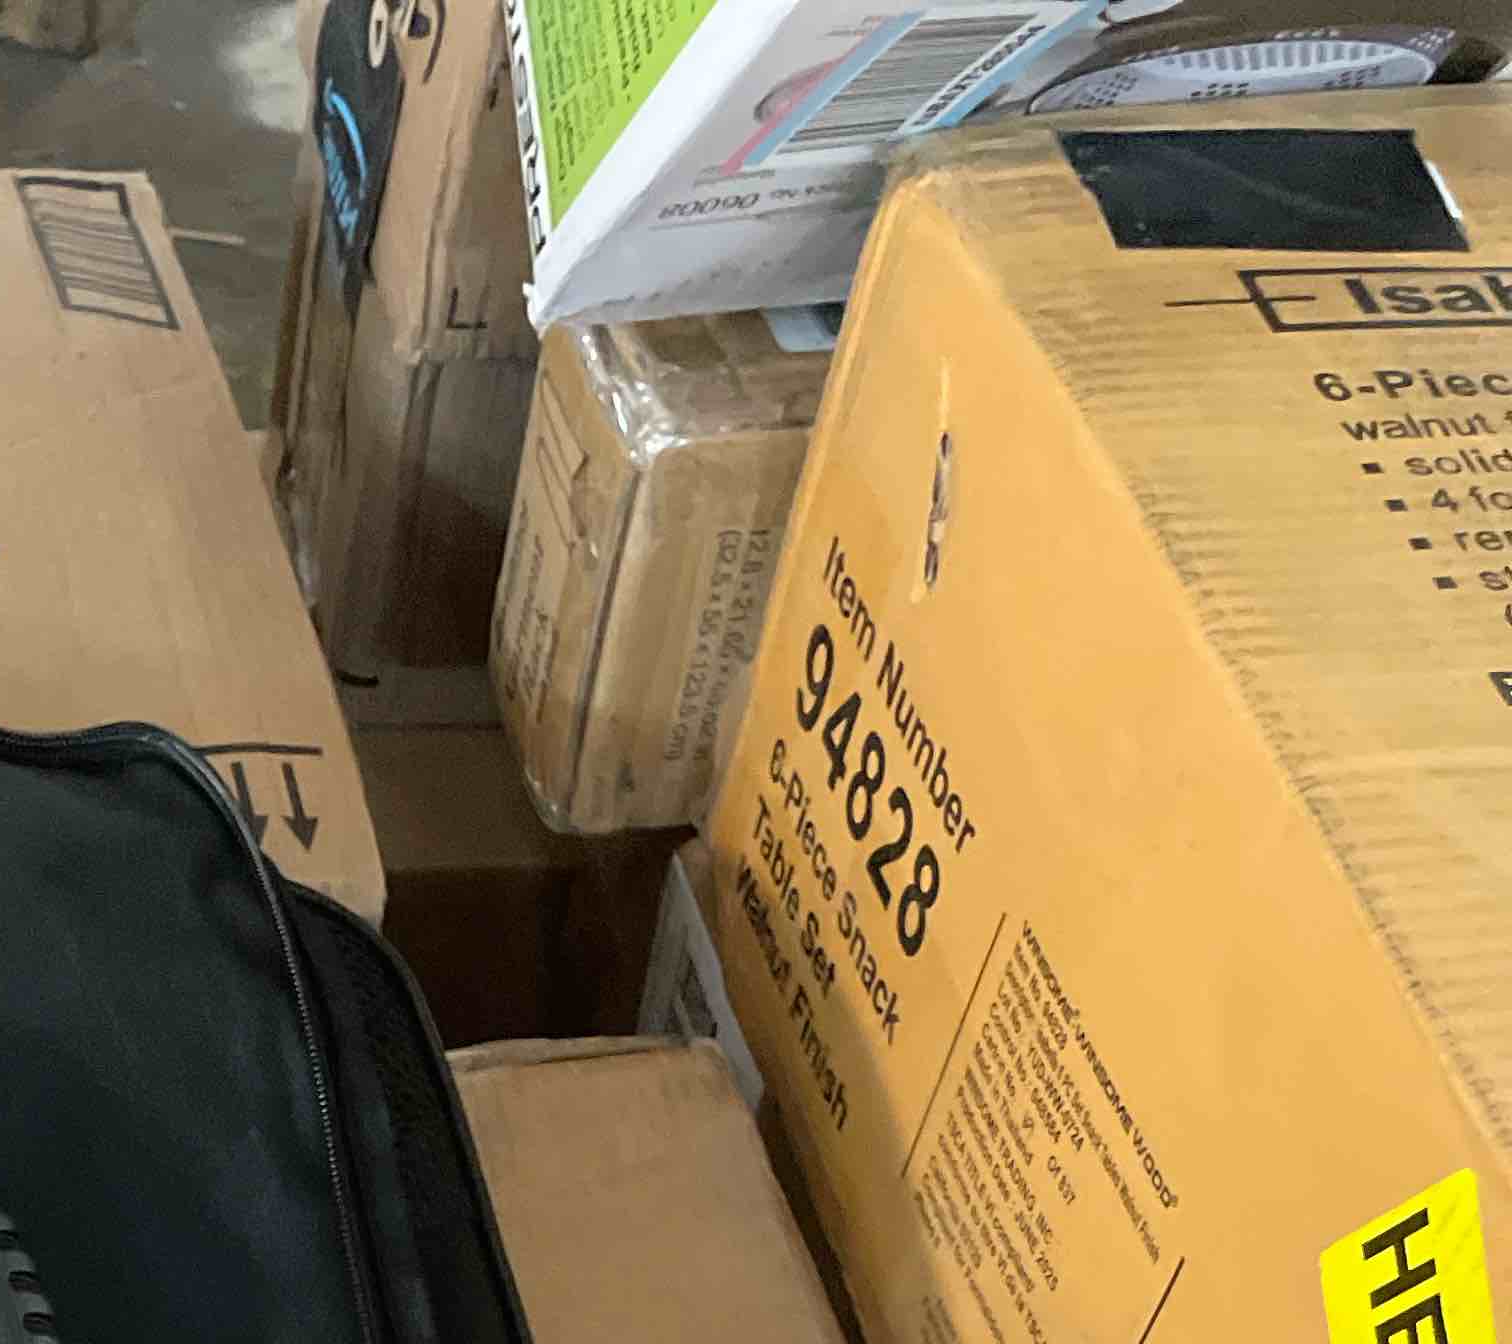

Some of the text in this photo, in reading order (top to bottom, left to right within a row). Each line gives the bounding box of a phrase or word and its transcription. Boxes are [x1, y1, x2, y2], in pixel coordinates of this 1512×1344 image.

[1341, 412, 1494, 440] walnut
[1431, 488, 1459, 513] 4
[823, 535, 976, 854] Item Number
[796, 623, 940, 958] 94828
[752, 795, 836, 1000] Table Set
[837, 890, 900, 1046] Snack
[791, 983, 848, 1133] Finish
